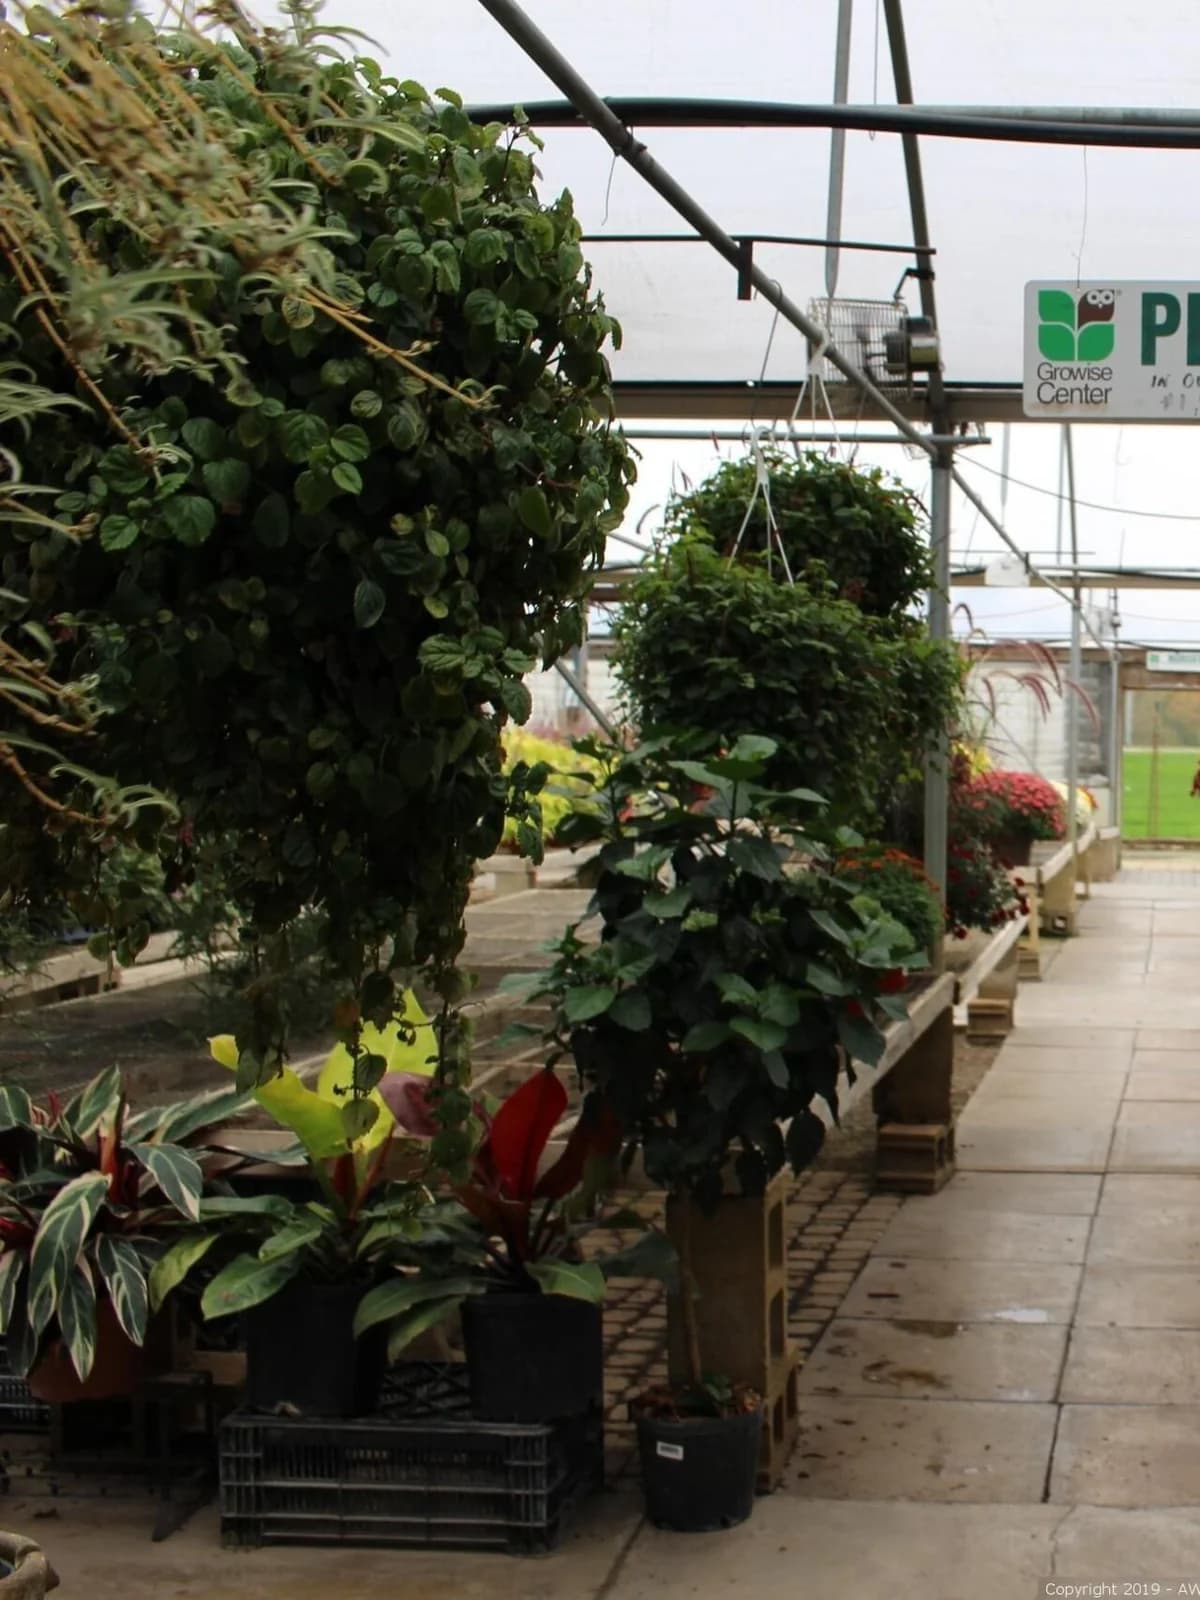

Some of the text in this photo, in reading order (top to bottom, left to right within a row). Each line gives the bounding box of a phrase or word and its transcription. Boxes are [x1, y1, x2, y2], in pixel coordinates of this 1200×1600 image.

[1037, 361, 1113, 381] Growise
[1151, 374, 1168, 388] IN
[1036, 381, 1113, 405] Center
